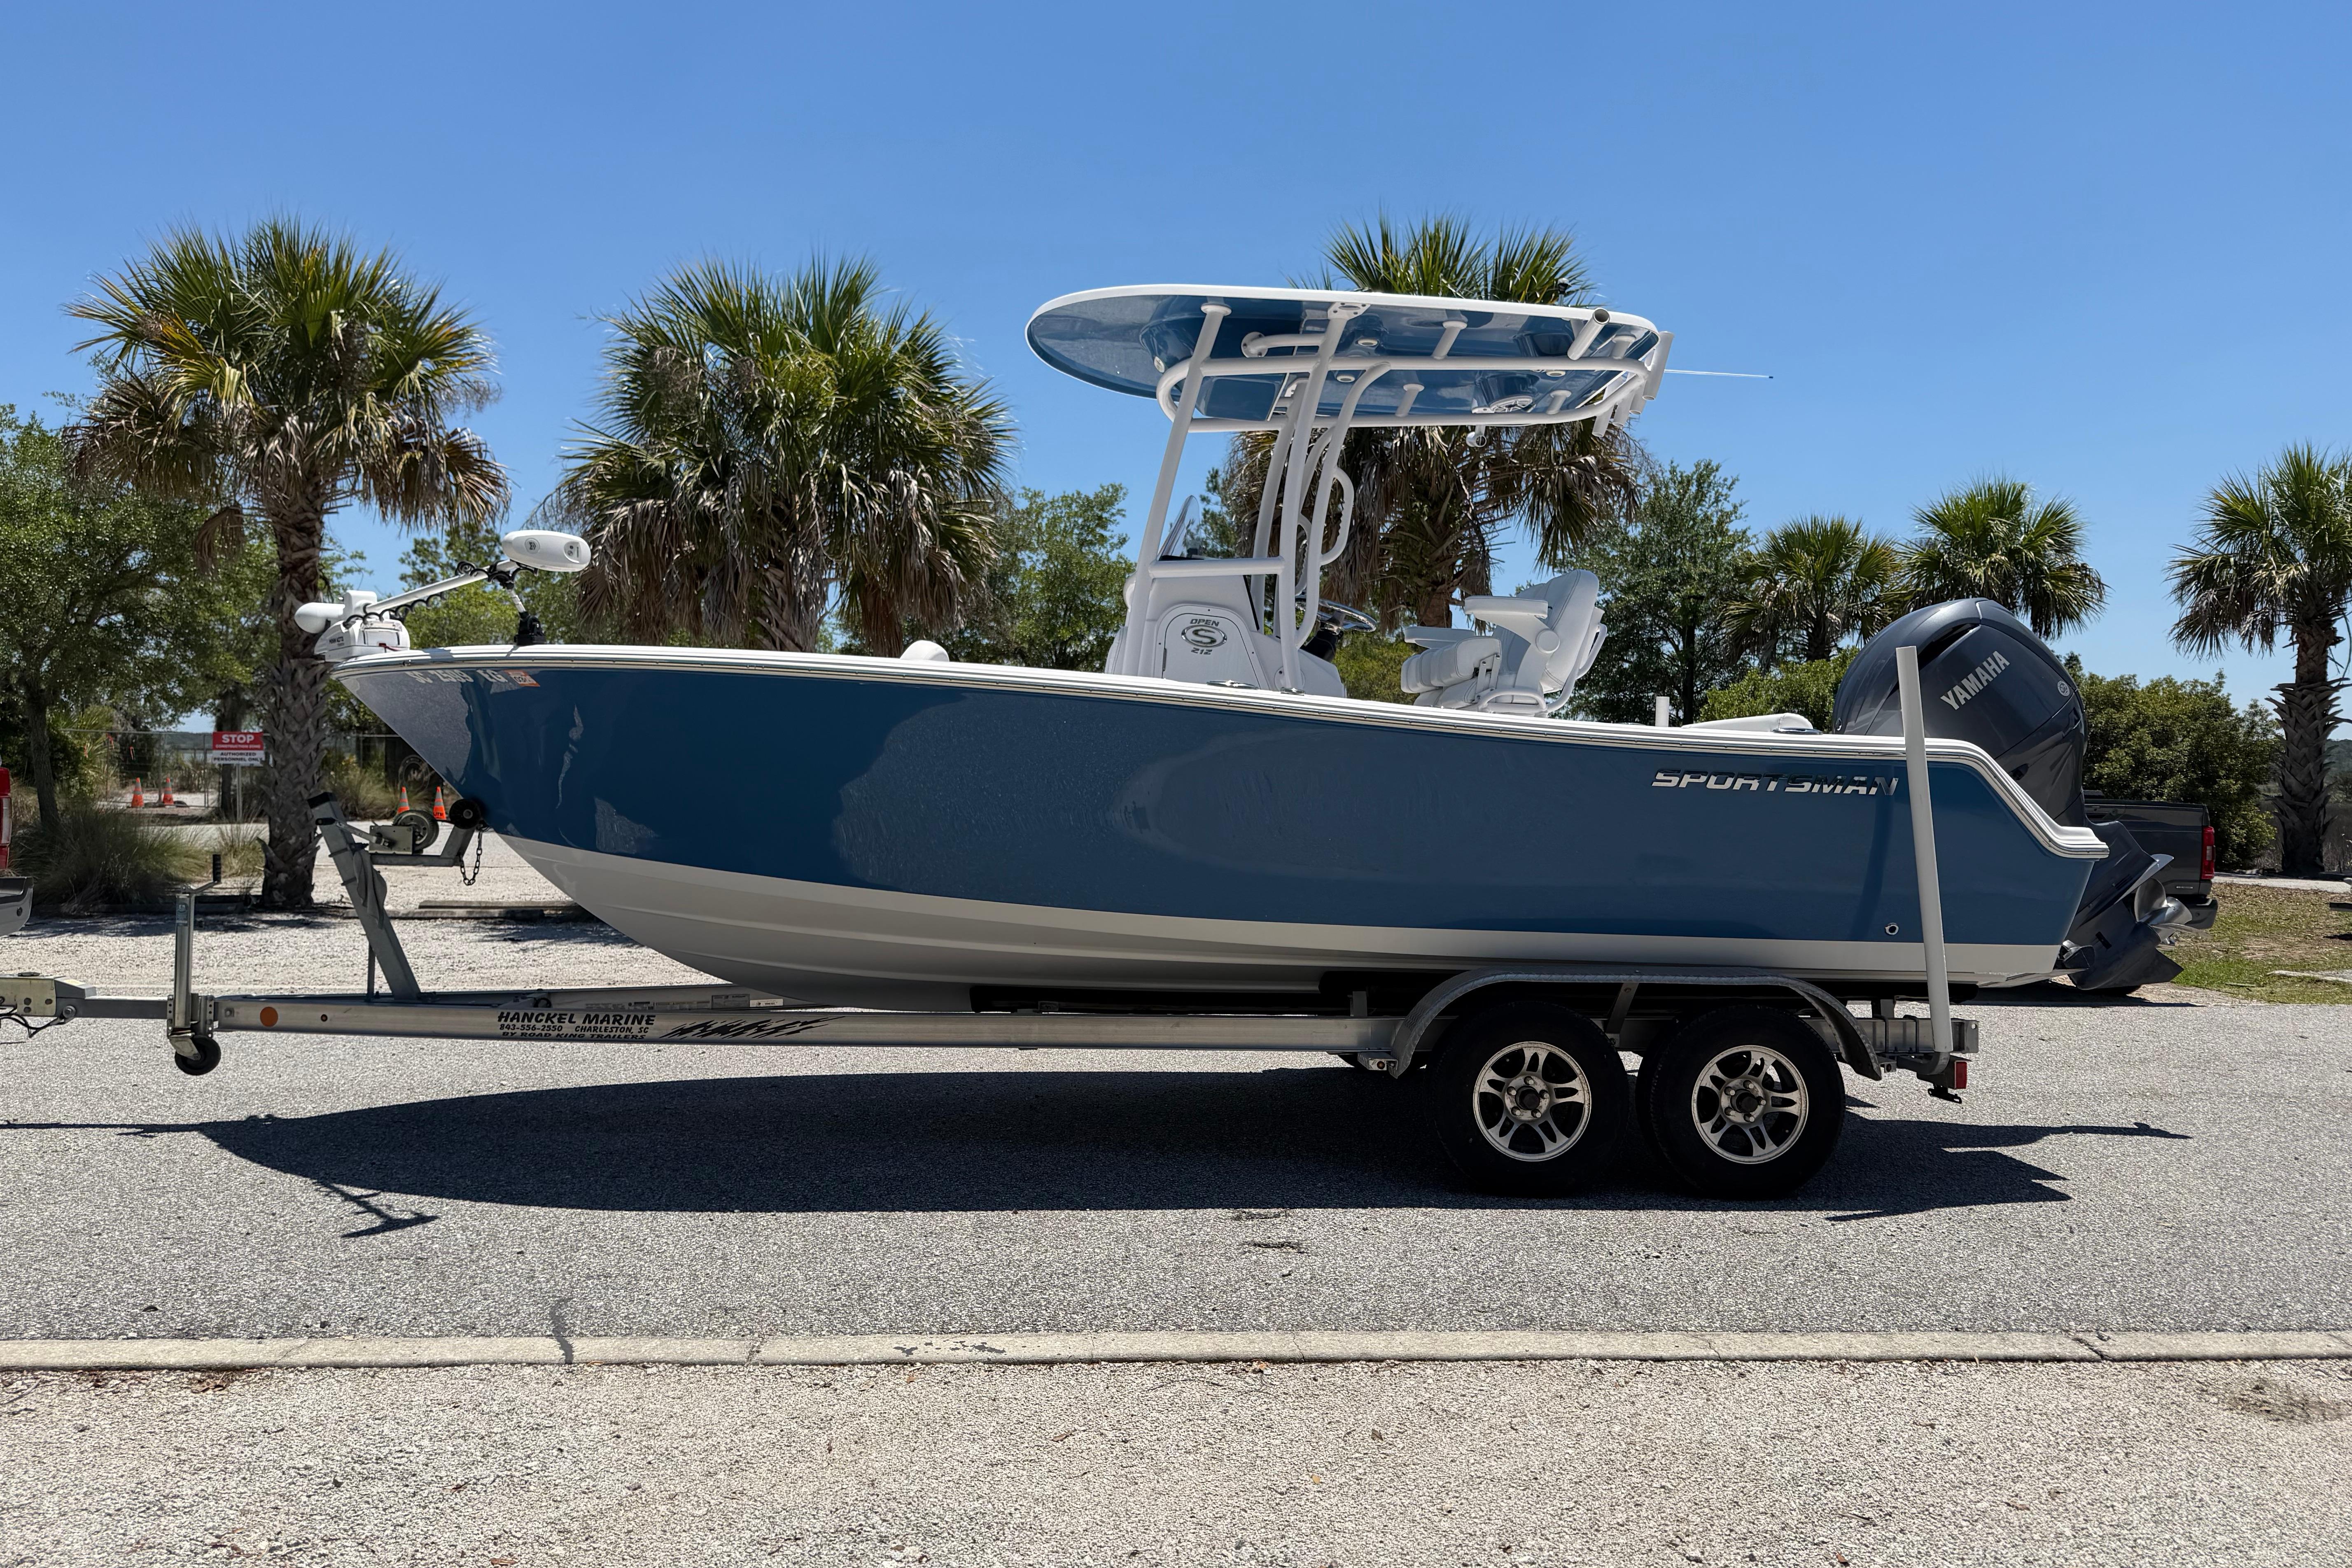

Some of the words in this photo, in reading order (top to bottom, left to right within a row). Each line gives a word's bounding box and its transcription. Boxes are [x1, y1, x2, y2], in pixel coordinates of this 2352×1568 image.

[1191, 628, 1217, 644] S
[1940, 651, 2010, 710] YAMAHA
[222, 734, 254, 743] STOP
[1651, 769, 1899, 796] SPORTSMAN
[498, 1012, 576, 1024] HANCKEL
[582, 1013, 656, 1026] MARINE
[499, 1024, 563, 1032] 843-556-2550
[575, 1026, 634, 1034] CHARLESTON,
